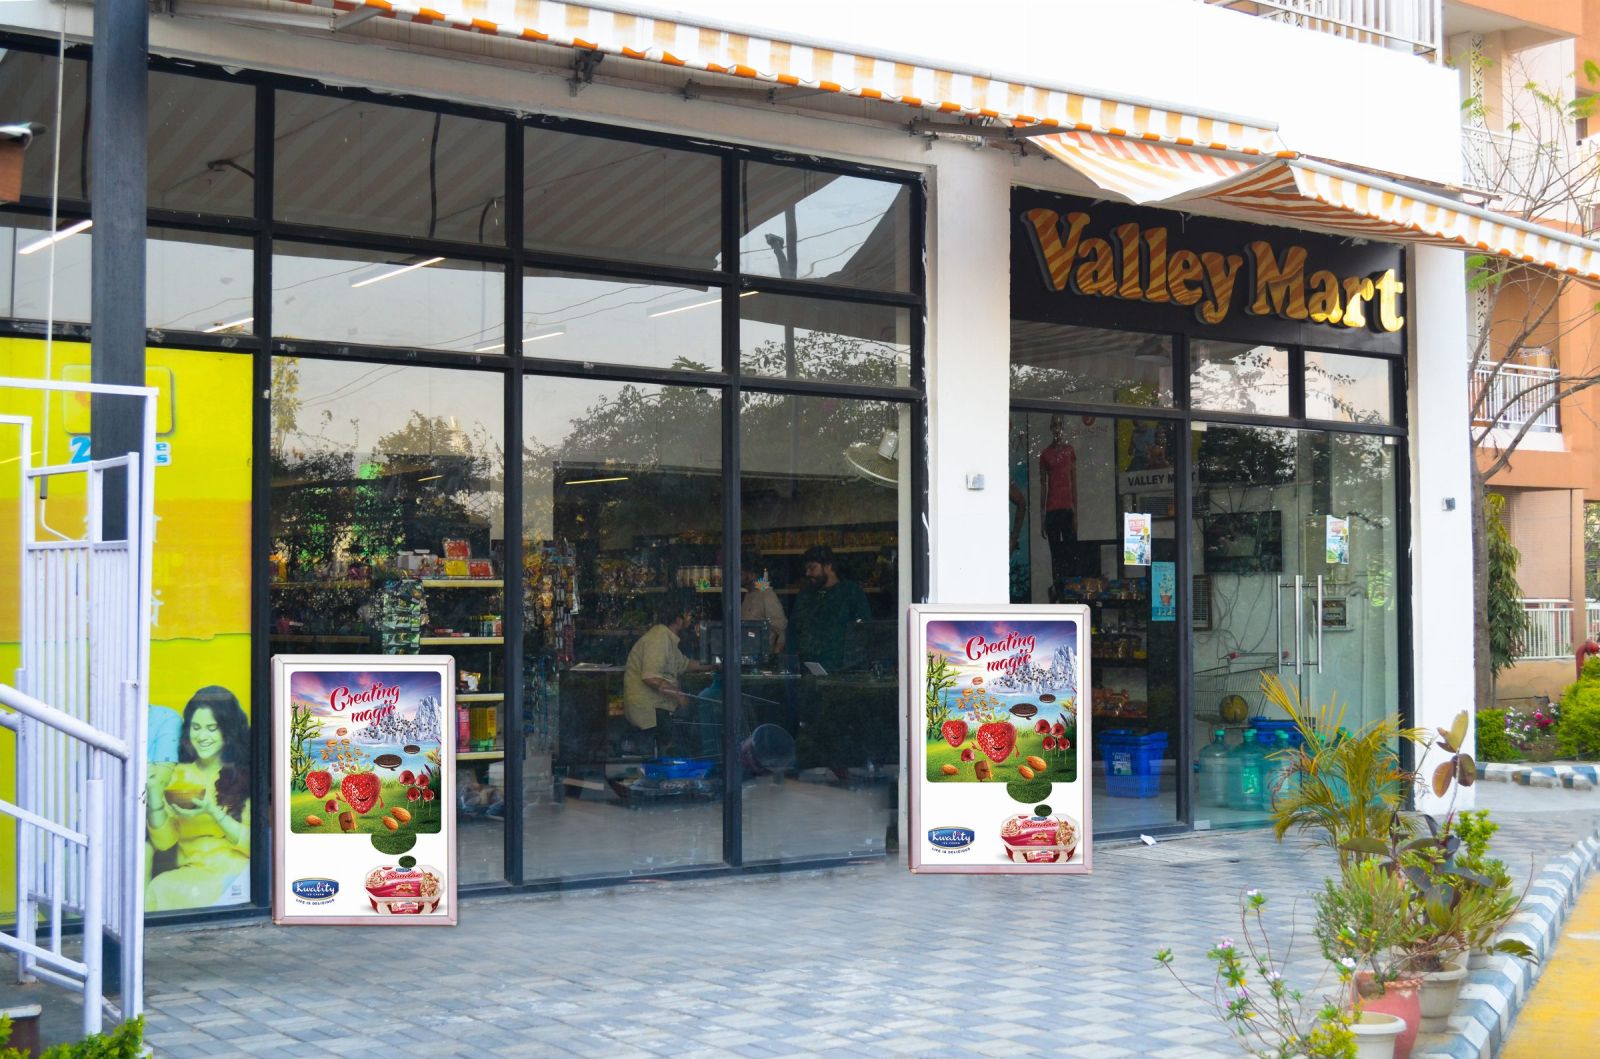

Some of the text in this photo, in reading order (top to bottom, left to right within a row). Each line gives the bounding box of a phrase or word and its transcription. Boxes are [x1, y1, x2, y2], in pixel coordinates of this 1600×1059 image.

[1022, 208, 1404, 334] Valley Mart
[1127, 474, 1165, 487] VALLEY
[966, 632, 1036, 661] Creating
[987, 649, 1031, 676] magic
[330, 682, 400, 711] Creating
[352, 699, 396, 727] magic
[932, 831, 971, 844] Kwality
[295, 881, 335, 895] Kwality
